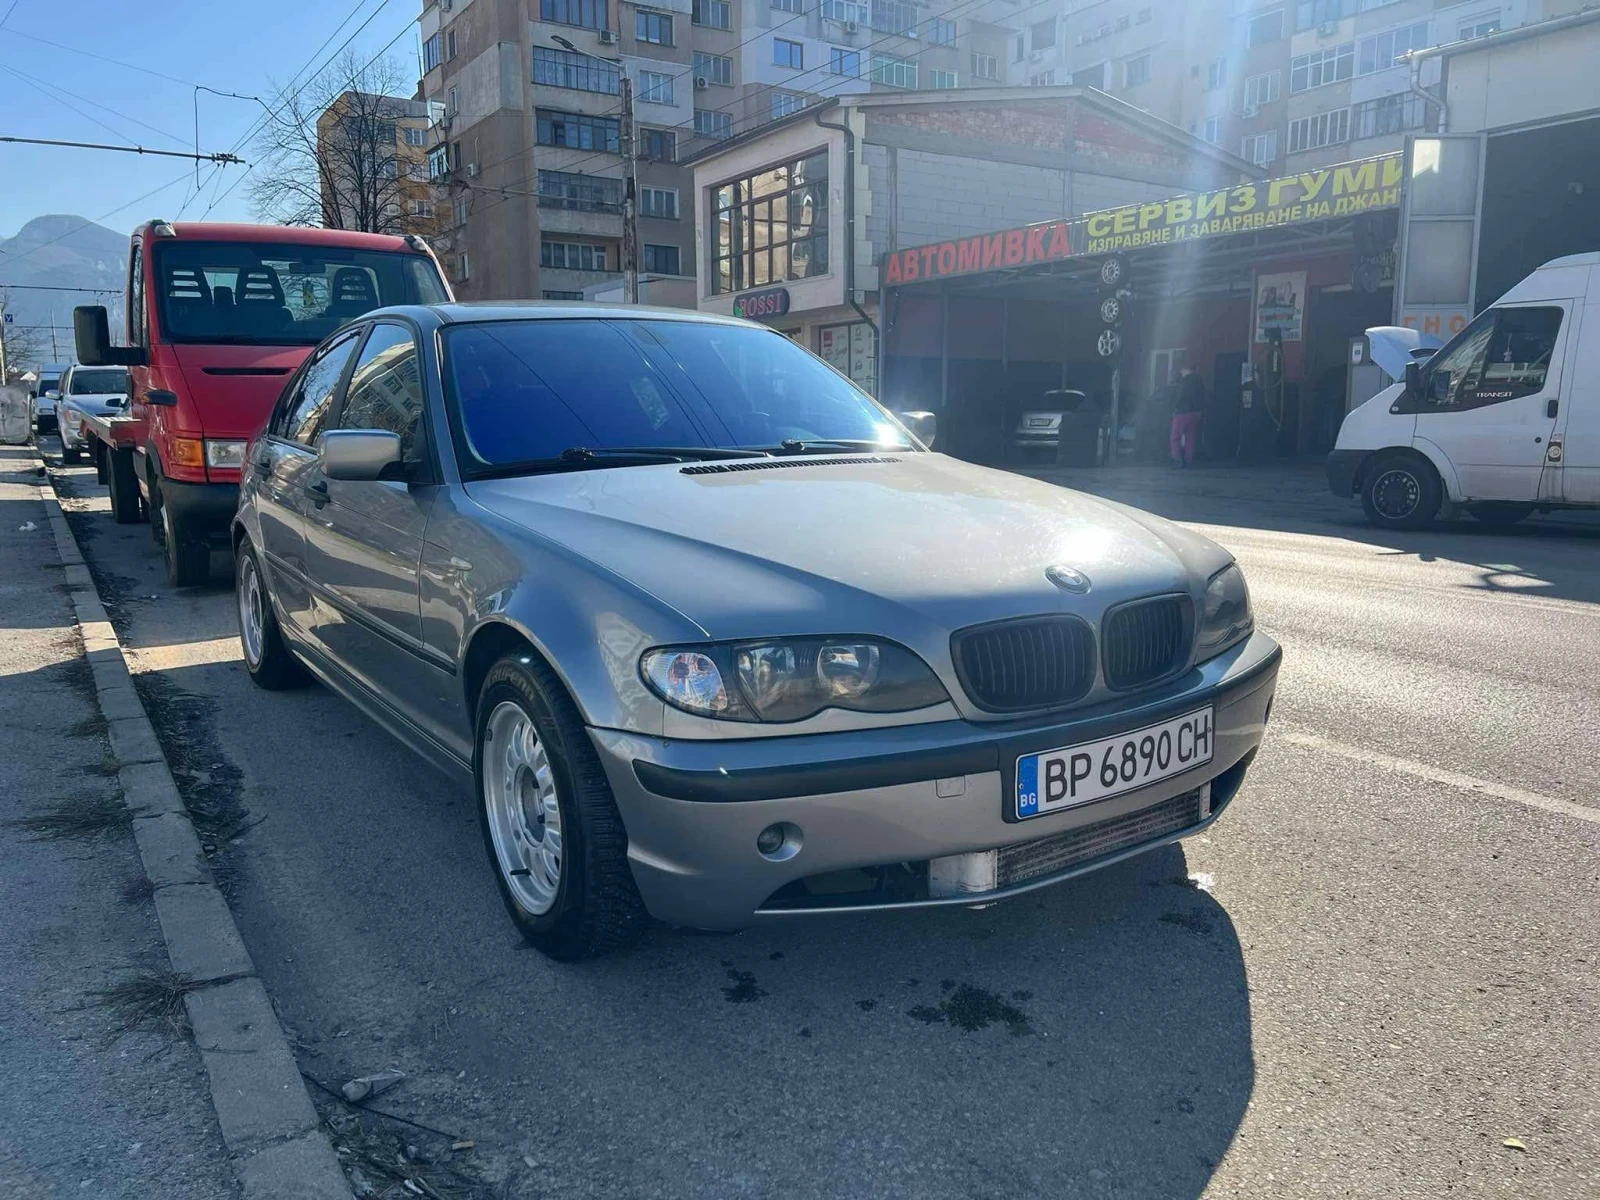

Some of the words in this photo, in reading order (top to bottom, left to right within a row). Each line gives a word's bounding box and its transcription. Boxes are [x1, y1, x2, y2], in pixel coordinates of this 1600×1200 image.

[1087, 186, 1256, 237] СЕРВИЗ
[1088, 227, 1171, 252] ИЗПРАВЯНЕ
[1175, 224, 1185, 239] И
[1190, 205, 1302, 238] ЗАВАРЯВАНЕ
[1306, 201, 1330, 219] НА
[1333, 188, 1401, 216] ДЖАН
[885, 222, 1070, 283] АВТОМИВКА
[739, 293, 782, 316] ROSSI
[1045, 753, 1092, 803] BP
[1100, 730, 1172, 788] 6890
[1177, 714, 1208, 763] CH
[1020, 792, 1036, 808] BG
